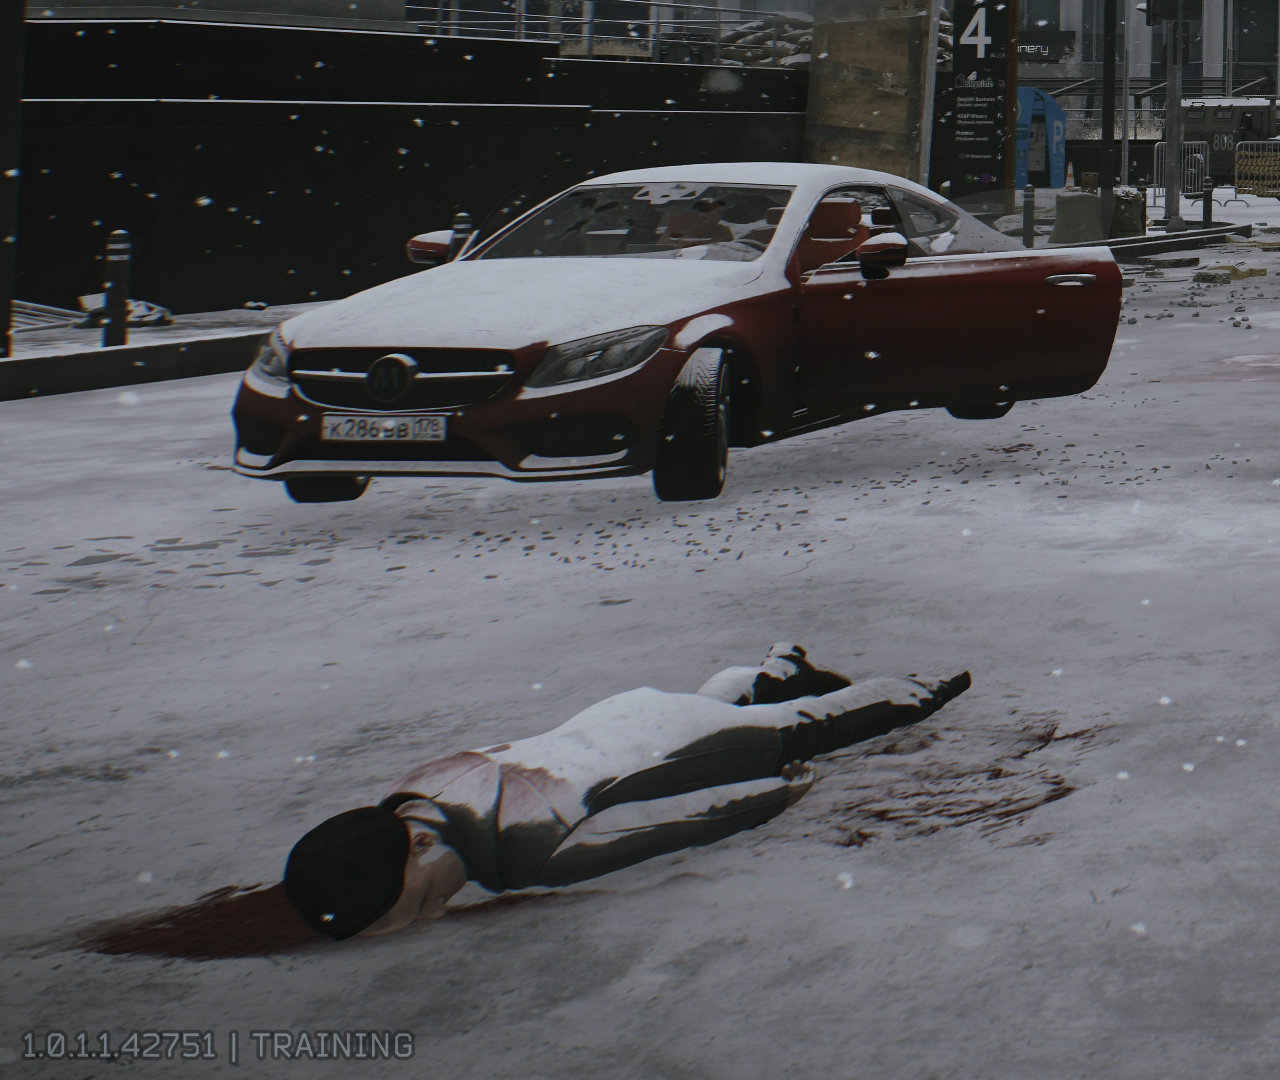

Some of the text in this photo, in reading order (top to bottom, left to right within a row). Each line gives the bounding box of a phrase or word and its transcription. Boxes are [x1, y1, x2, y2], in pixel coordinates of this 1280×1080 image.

[959, 7, 992, 59] 4
[1017, 44, 1049, 56] inery
[1052, 119, 1064, 154] P
